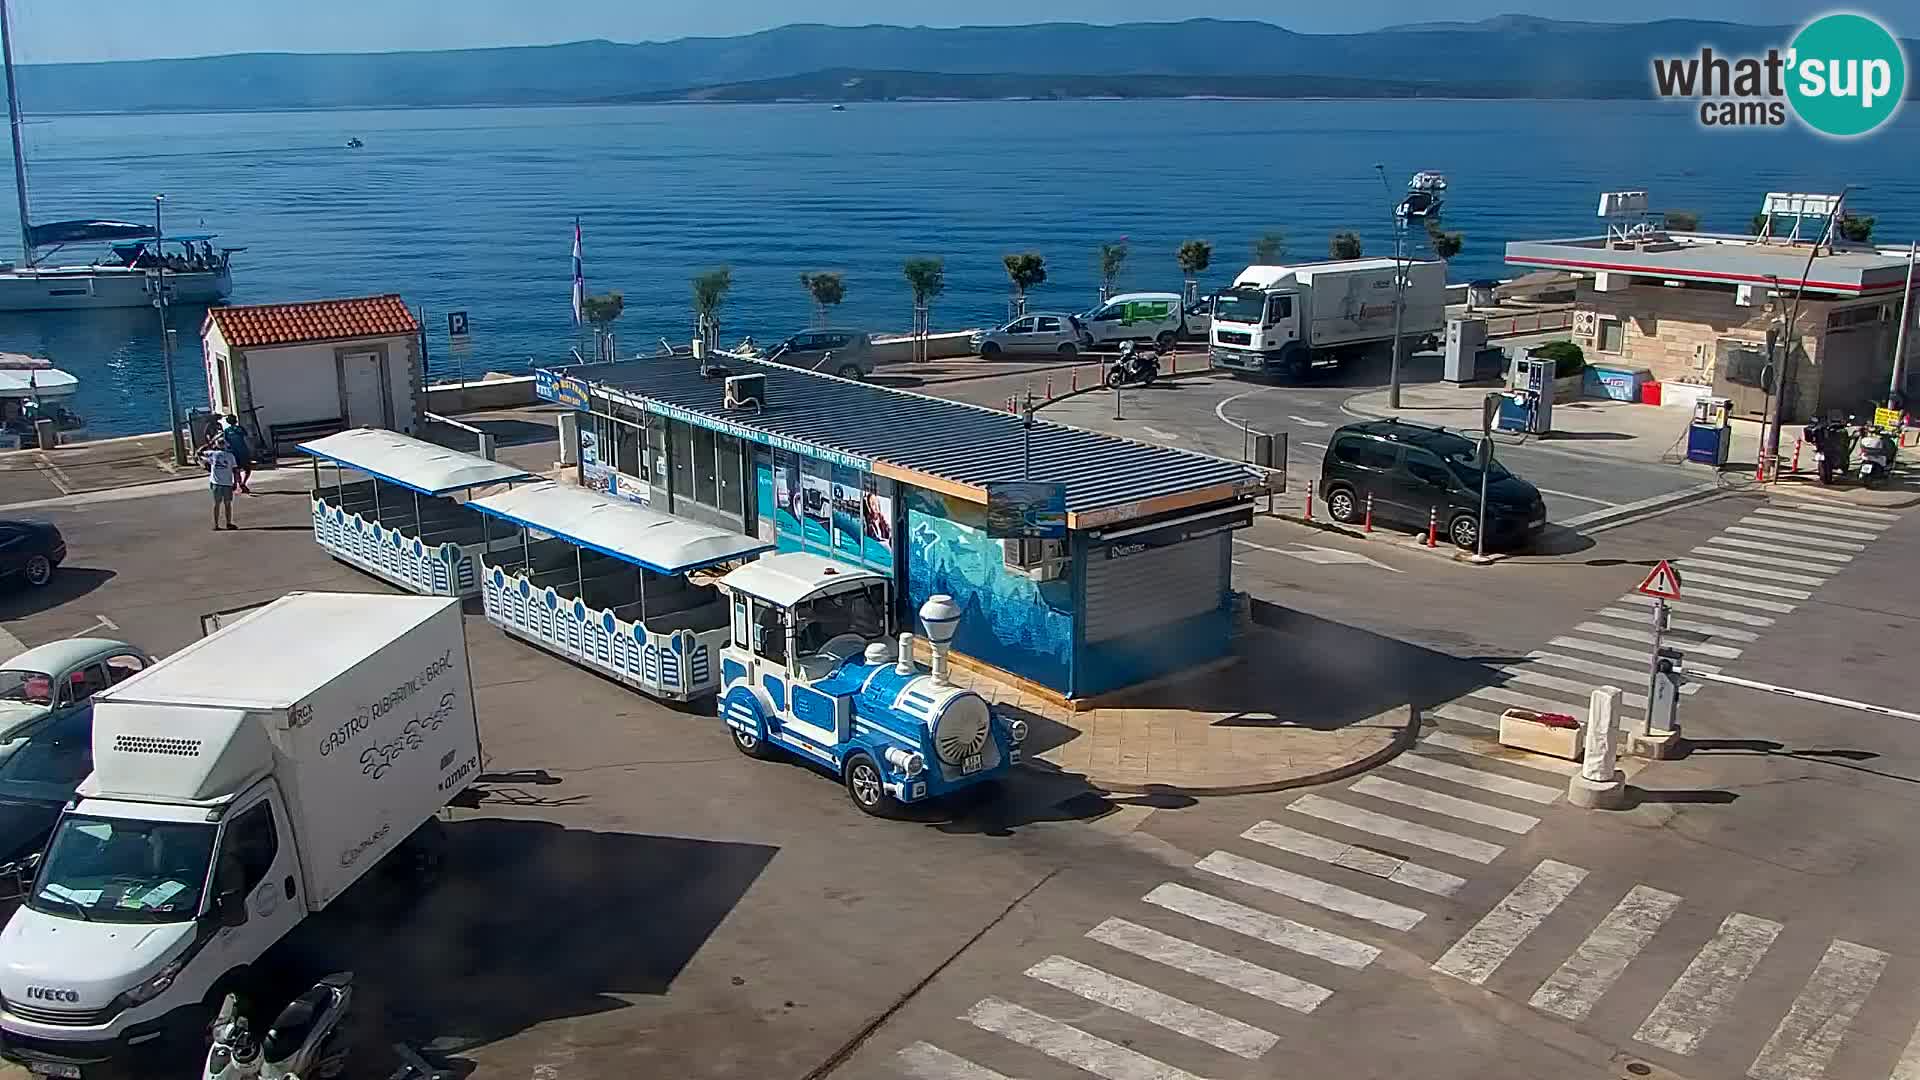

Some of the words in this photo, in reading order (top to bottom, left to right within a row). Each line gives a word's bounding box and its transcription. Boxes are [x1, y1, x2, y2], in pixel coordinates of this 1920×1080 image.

[692, 414, 728, 431] AUTOBUSNA
[729, 423, 759, 440] POSTAJA
[768, 435, 782, 447] BUS
[783, 439, 814, 457] STATION
[815, 448, 840, 463] TICKET
[841, 455, 867, 470] OFFICE
[319, 712, 370, 757] GASTRO
[445, 756, 477, 789] amare
[27, 986, 80, 1003] IVECO
